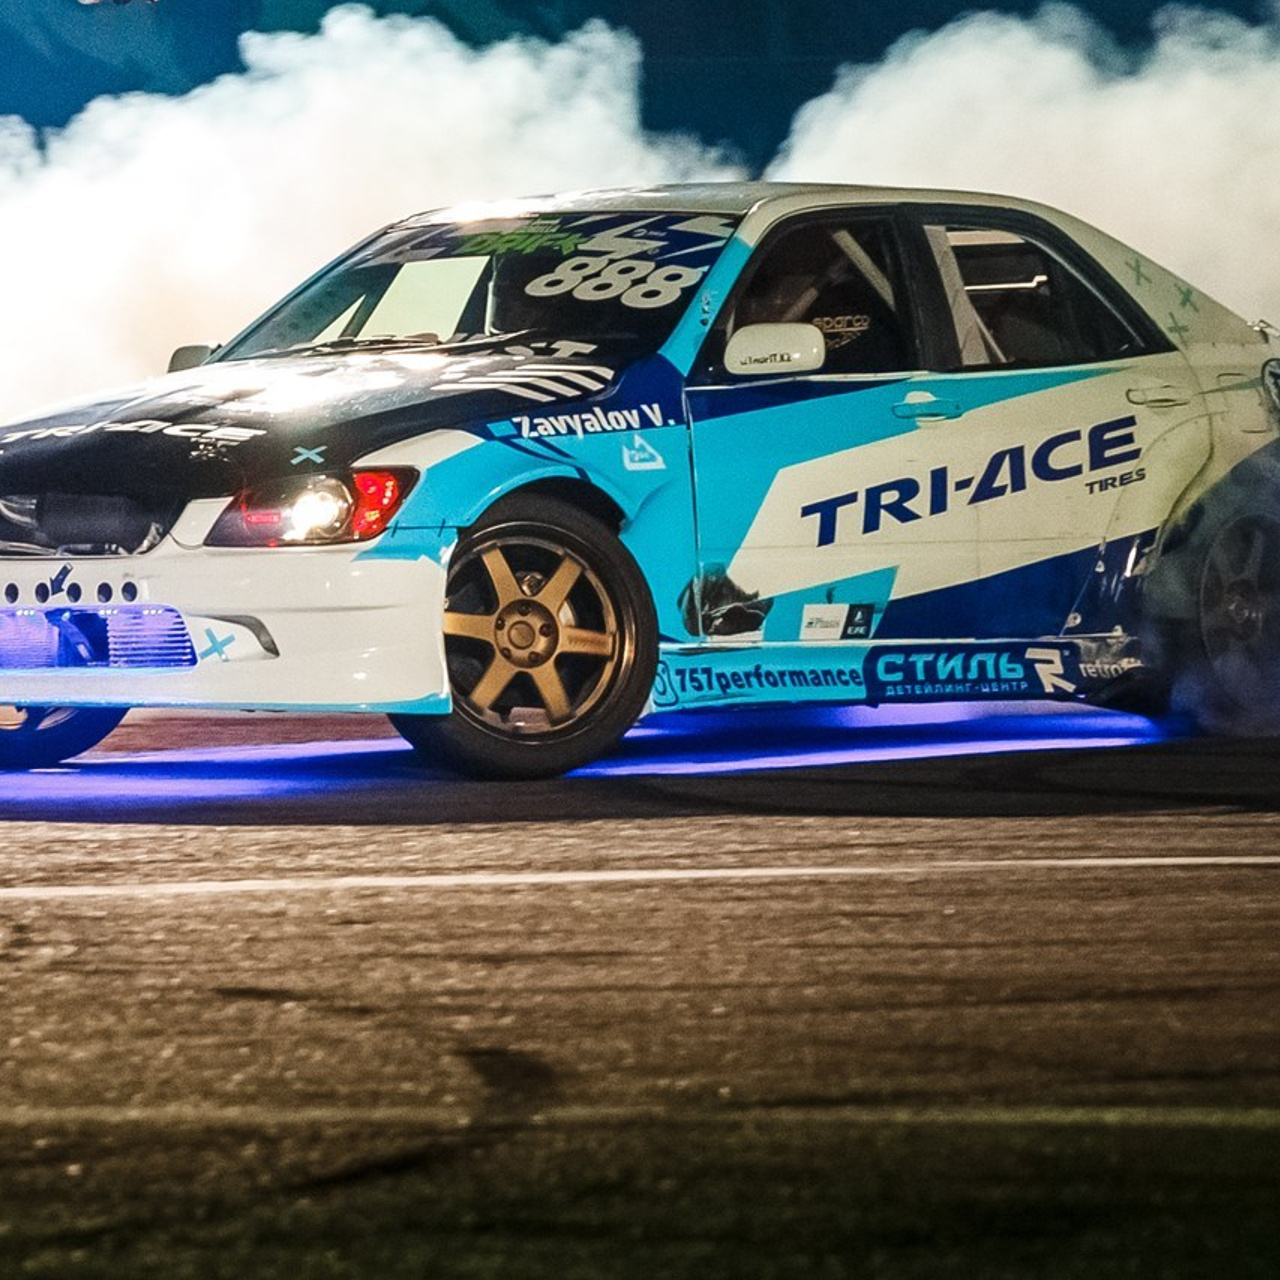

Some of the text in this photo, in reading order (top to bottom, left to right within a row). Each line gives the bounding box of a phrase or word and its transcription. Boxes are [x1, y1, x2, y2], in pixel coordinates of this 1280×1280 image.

[524, 255, 708, 309] 888
[511, 403, 676, 440] Zavyalov V.
[801, 415, 1142, 548] TRI-ACE
[1085, 468, 1146, 495] TIRES
[675, 665, 864, 693] 757performance
[877, 652, 1024, 682] СТИЛЬ
[886, 681, 1028, 696] ДЕТЕЙЛИНГ-ЦЕНТР
